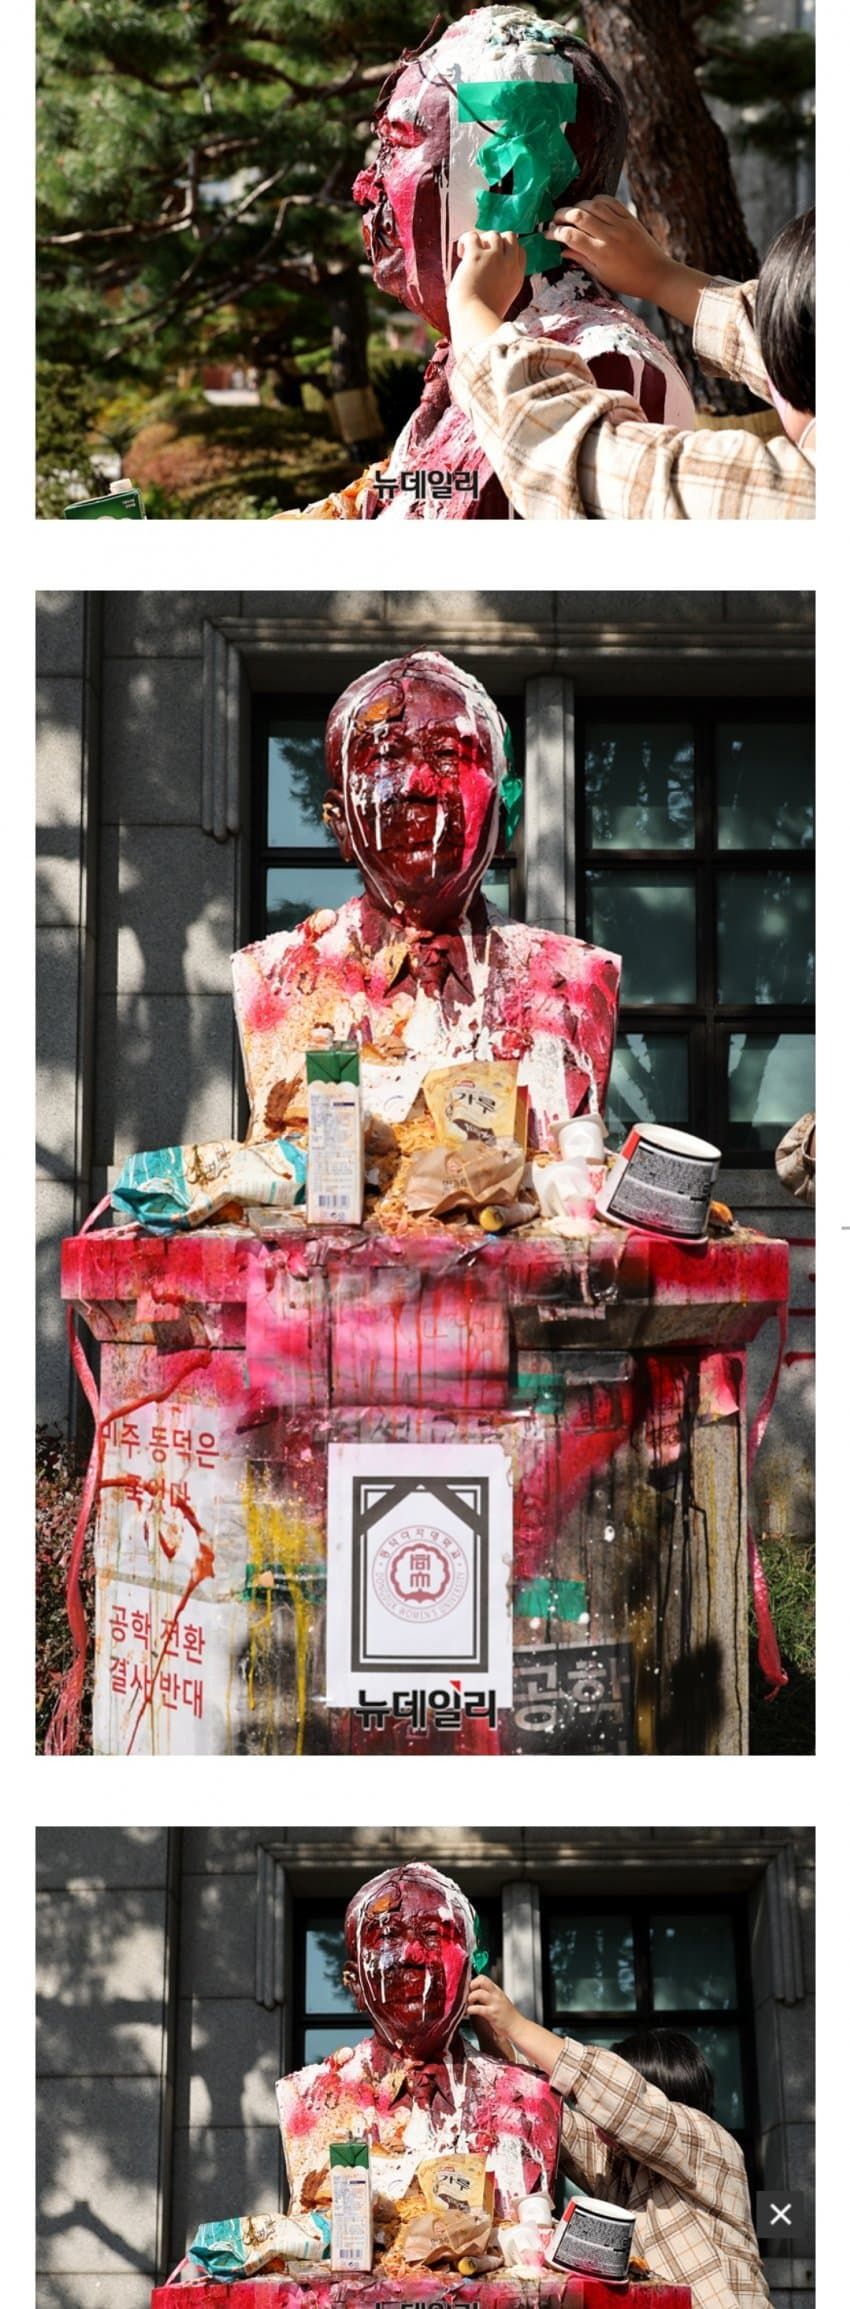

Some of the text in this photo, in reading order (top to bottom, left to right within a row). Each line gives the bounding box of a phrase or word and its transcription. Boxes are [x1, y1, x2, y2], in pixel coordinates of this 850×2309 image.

[149, 1426, 219, 1469] 동덕은
[109, 1605, 206, 1665] 공학 전환
[109, 1655, 203, 1719] 결사 반대
[513, 1657, 631, 1732] 공학
